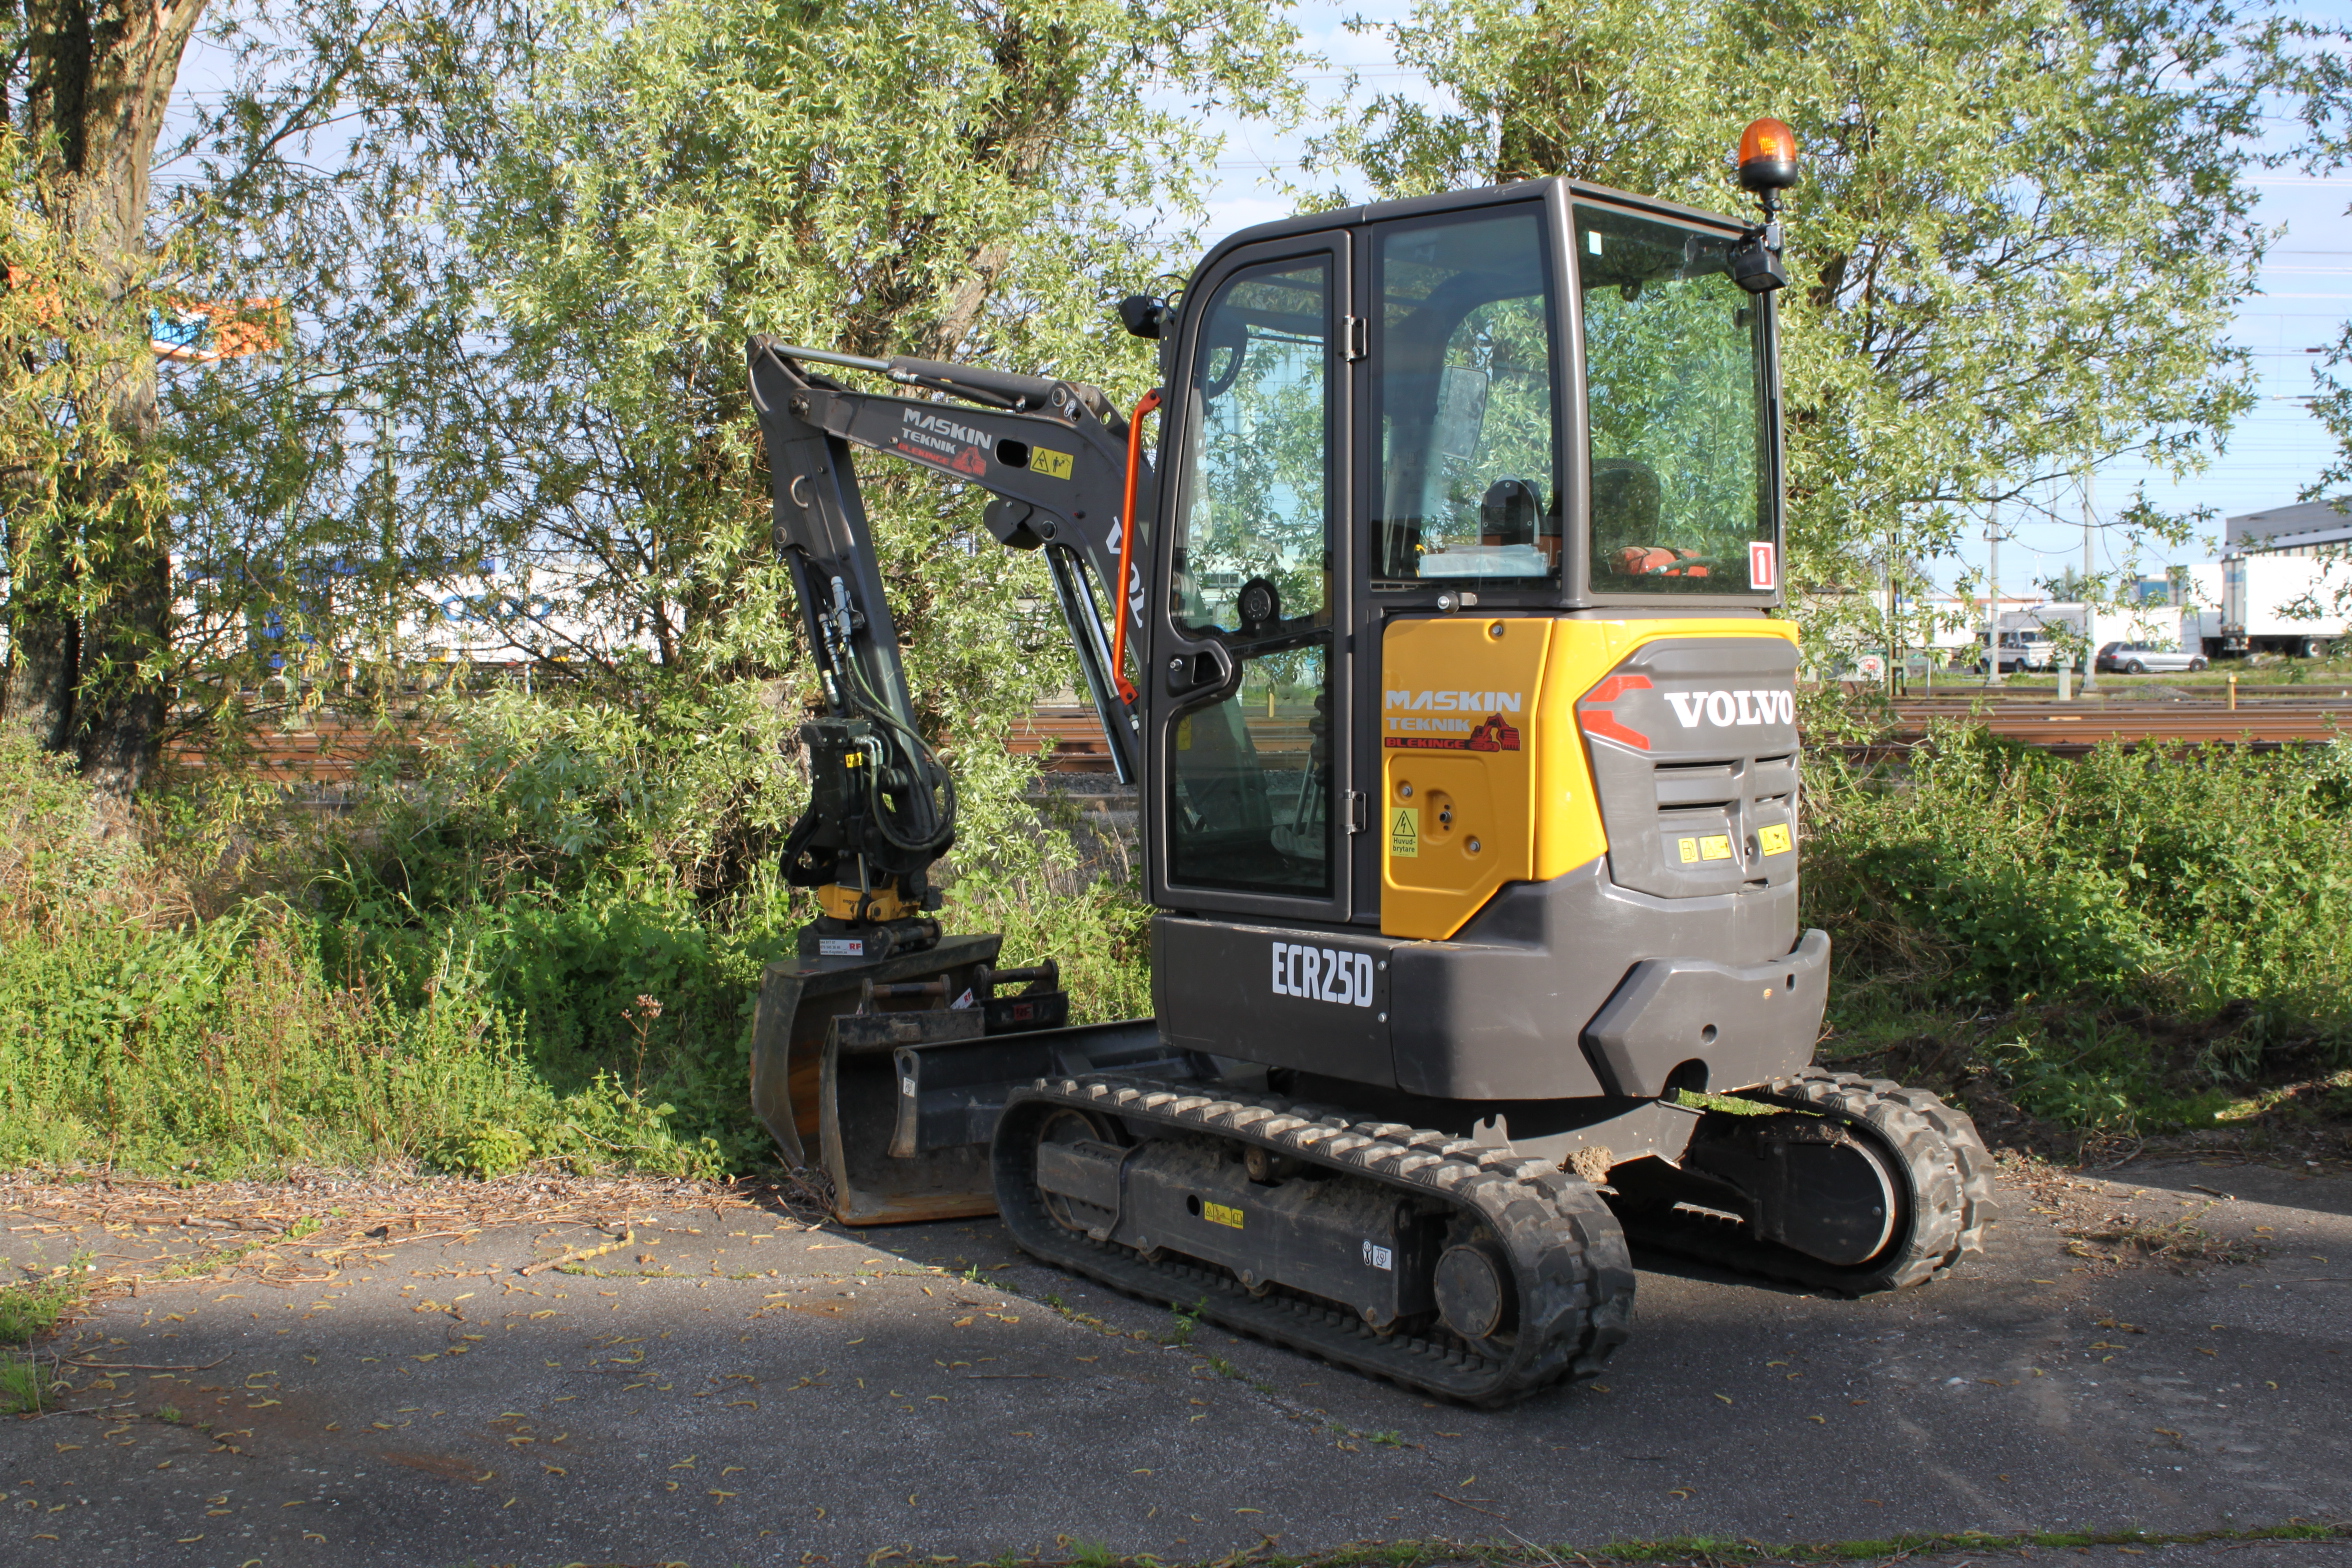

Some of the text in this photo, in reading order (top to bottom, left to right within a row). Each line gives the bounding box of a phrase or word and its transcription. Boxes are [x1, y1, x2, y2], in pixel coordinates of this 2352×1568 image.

[903, 407, 992, 450] MASKIN
[902, 427, 957, 455] TEKNIK
[1385, 690, 1522, 712] MASKIN
[1663, 690, 1794, 728] VOLVO
[1386, 717, 1471, 732] TEKNIK
[1386, 738, 1466, 749] BLEKINGE
[1392, 845, 1416, 853] brytare
[1393, 837, 1416, 845] Huvud-
[1272, 941, 1374, 1008] ECR25D
